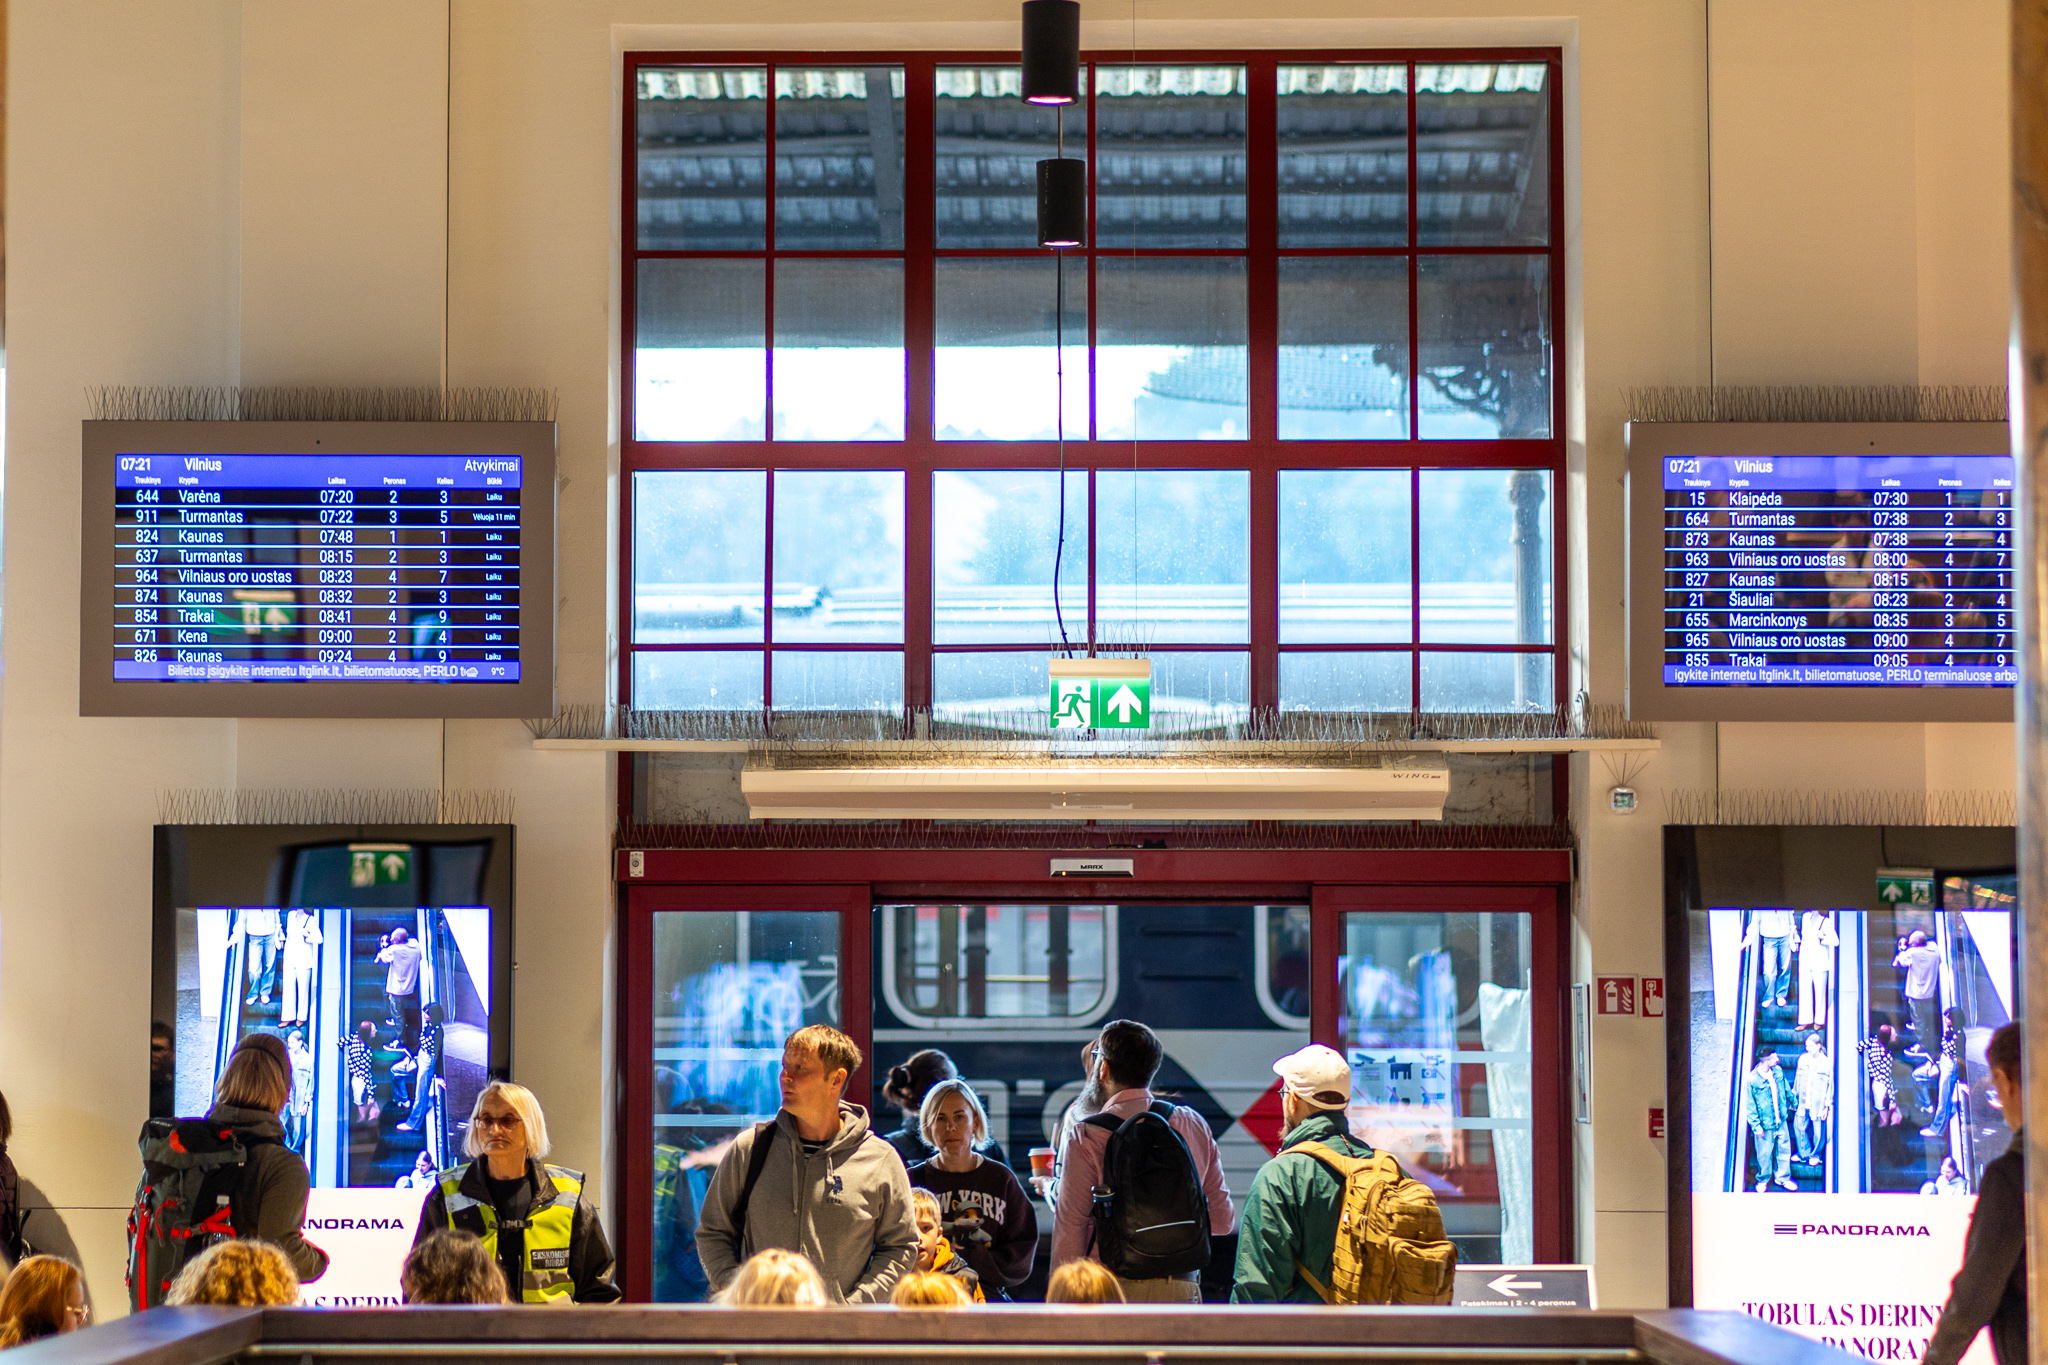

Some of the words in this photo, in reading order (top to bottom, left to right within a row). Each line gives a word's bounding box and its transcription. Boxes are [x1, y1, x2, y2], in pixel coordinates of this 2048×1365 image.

[121, 458, 150, 470] 07:21
[184, 458, 221, 471] Vilnius
[465, 459, 518, 474] Atvykimai
[1670, 460, 1700, 473] 07:21
[1735, 460, 1773, 473] Vilnius
[179, 477, 198, 485] Kryptis
[1684, 479, 1711, 488] Traukinys
[1729, 479, 1749, 487] Kryptis
[137, 490, 158, 502] 644
[179, 490, 220, 502] Varėna
[321, 490, 353, 503] 07:20
[390, 491, 397, 503] 2
[440, 491, 447, 503] 3
[1690, 492, 1705, 505] 15
[1730, 492, 1781, 508] Klaipėda
[1874, 492, 1909, 505] 07:30
[1946, 493, 1952, 505] 1
[1998, 493, 2004, 505] 1
[137, 510, 156, 522] 911
[179, 510, 242, 523] Turmantas
[321, 510, 352, 523] 07:22
[390, 511, 397, 523] 3
[441, 511, 447, 523] 5
[1686, 513, 1710, 526] 664
[1729, 513, 1795, 525] Turmantas
[1874, 512, 1909, 525] 07:38
[1945, 513, 1954, 525] 2
[1997, 513, 2006, 525] 3
[136, 530, 158, 542] 824
[179, 530, 223, 542] Kaunas
[320, 530, 352, 543] 07:48
[390, 531, 394, 543] 1
[441, 531, 445, 543] 1
[1686, 533, 1708, 545] 873
[1730, 533, 1776, 545] Kaunas
[1874, 533, 1908, 546] 07:38
[1945, 532, 1953, 545] 2
[1997, 533, 2006, 545] 4
[136, 549, 158, 562] 637
[178, 550, 242, 562] Turmantas
[320, 550, 352, 563] 08:15
[390, 550, 396, 563] 2
[440, 551, 447, 563] 3
[1686, 553, 1708, 565] 963
[1729, 553, 1778, 566] Vilniaus
[1781, 556, 1801, 565] oro
[1805, 552, 1846, 565] uostas
[1874, 552, 1908, 567] 08:00
[1945, 553, 1954, 565] 4
[1997, 553, 2006, 565] 7
[136, 570, 158, 582] 964
[178, 569, 225, 582] Vilniaus
[229, 573, 248, 582] oro
[252, 571, 291, 583] uostas
[320, 570, 352, 583] 08:23
[389, 570, 396, 583] 4
[440, 570, 447, 583] 7
[1686, 573, 1709, 586] 827
[1730, 573, 1775, 586] Kaunas
[1874, 572, 1908, 586] 08:15
[1946, 574, 1951, 586] 1
[1998, 574, 2004, 586] 1
[136, 589, 158, 602] 874
[179, 590, 222, 602] Kaunas
[320, 590, 352, 603] 08:32
[389, 590, 396, 603] 2
[440, 591, 446, 603] 3
[1690, 593, 1703, 606] 21
[1729, 591, 1772, 606] Šiauliai
[1874, 593, 1908, 606] 08:23
[1945, 594, 1953, 606] 2
[1997, 594, 2006, 606] 4
[135, 609, 157, 622] 854
[178, 609, 213, 622] Trakai
[320, 610, 350, 623] 08:41
[389, 610, 396, 623] 4
[439, 611, 446, 623] 9
[1686, 614, 1710, 626] 655
[1730, 613, 1807, 628] Marcinkonys
[1874, 614, 1909, 626] 08:35
[1945, 614, 1954, 626] 3
[1998, 614, 2006, 626] 5
[135, 629, 155, 642] 671
[178, 630, 207, 642] Kena
[319, 630, 352, 643] 09:00
[389, 630, 396, 643] 2
[439, 631, 446, 643] 4
[1686, 634, 1709, 646] 965
[1729, 633, 1777, 646] Vilniaus
[1781, 637, 1801, 646] oro
[1805, 635, 1846, 647] uostas
[1874, 634, 1909, 647] 09:00
[1945, 634, 1954, 646] 4
[1997, 634, 2006, 647] 7
[134, 649, 157, 662] 826
[178, 650, 222, 662] Kaunas
[318, 650, 351, 663] 09:24
[389, 650, 396, 663] 4
[439, 650, 446, 663] 9
[1686, 654, 1709, 667] 855
[1729, 654, 1766, 667] Trakai
[1874, 654, 1908, 666] 09:05
[1945, 654, 1953, 666] 4
[1997, 654, 2005, 666] 9
[168, 665, 205, 676] Bilietus
[252, 665, 297, 676] internetu
[344, 665, 421, 677] bilietomatuose,
[424, 665, 458, 676] PERLO
[1711, 669, 1756, 680] internetu
[1805, 669, 1884, 682] bilietomatuose,
[1887, 669, 1921, 681] PERLO
[1924, 670, 1992, 681] terminaluose
[1995, 670, 2018, 681] arba
[958, 1190, 1006, 1226] YORK
[303, 1219, 404, 1229] NORAMA
[1802, 1224, 1930, 1236] PANORAMA
[1742, 1302, 1854, 1325] TOBULAS
